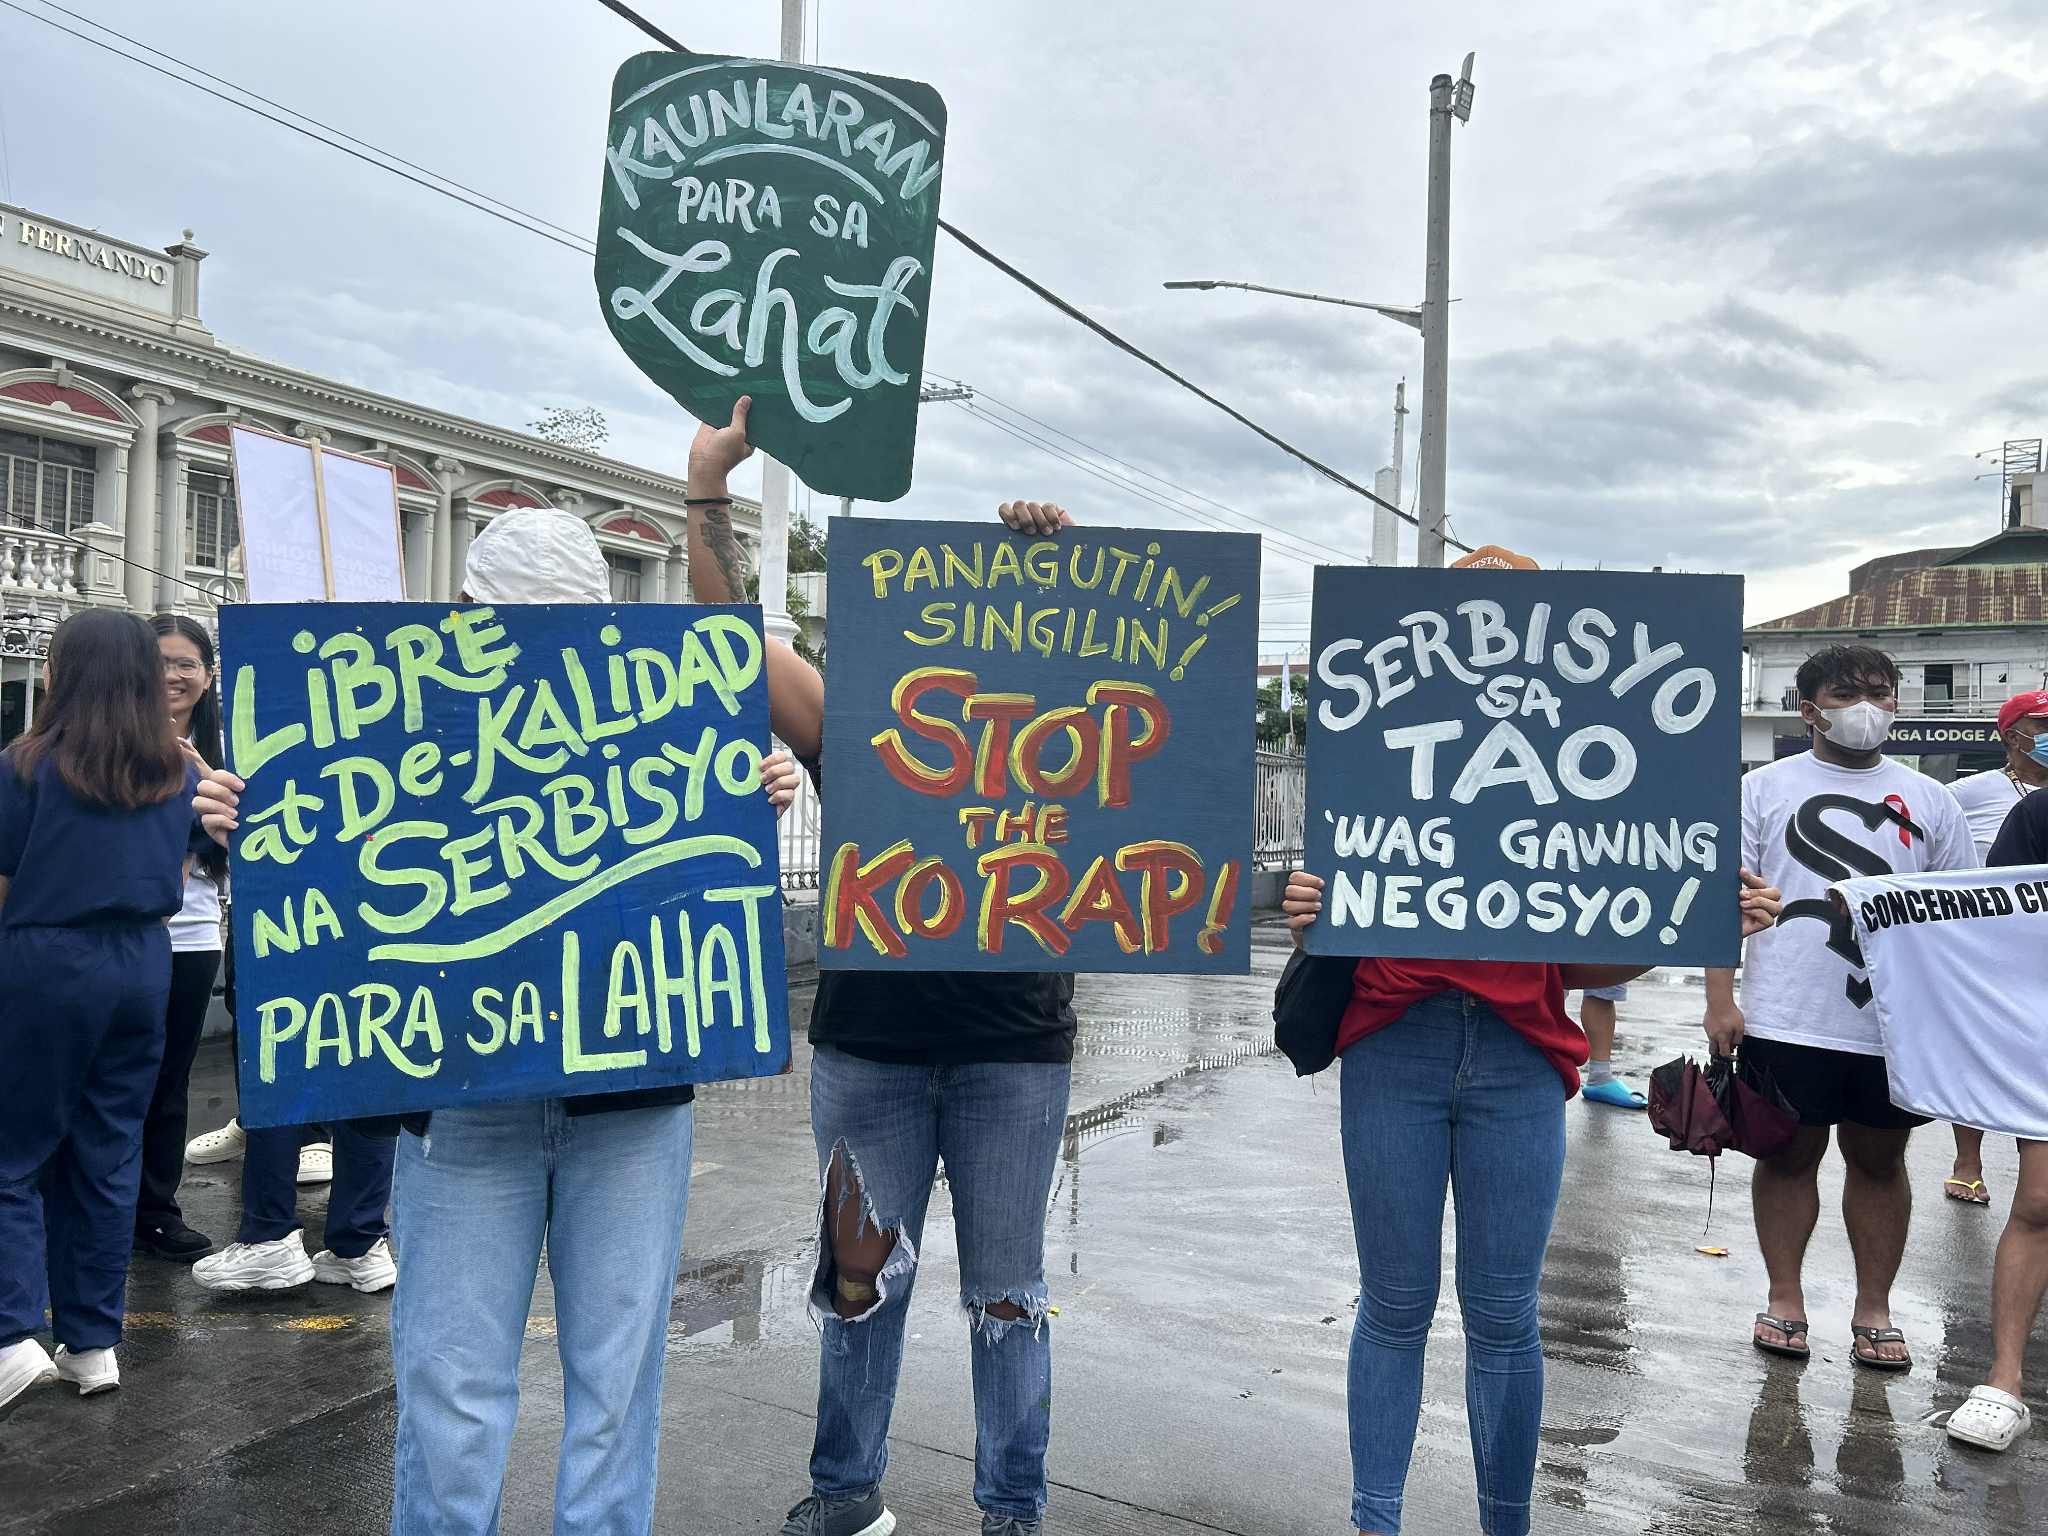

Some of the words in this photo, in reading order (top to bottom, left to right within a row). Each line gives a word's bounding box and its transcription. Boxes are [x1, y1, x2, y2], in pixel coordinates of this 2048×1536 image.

[606, 78, 942, 210] KAUNLARAN
[672, 176, 782, 233] PARA
[809, 194, 868, 248] SA
[18, 222, 168, 286] FERNANDO
[611, 226, 926, 423] Lahat
[1466, 556, 1513, 569] UTSTAND
[904, 600, 1208, 681] SINGILIN!
[1317, 600, 1717, 735] SERBISYO
[871, 666, 1172, 808] STOP
[1476, 675, 1562, 728] SA
[1926, 729, 1985, 741] LODGE
[1383, 719, 1638, 805] TAO
[240, 780, 324, 864] at
[959, 801, 1070, 849] THE
[1500, 817, 1719, 872] GAWING
[252, 887, 343, 958] NA
[1330, 870, 1700, 945] NEGOSYO!
[1861, 886, 2014, 933] CONCERNED
[256, 983, 444, 1084] PARA
[466, 981, 545, 1055] SA
[562, 886, 776, 1074] LAHAT
